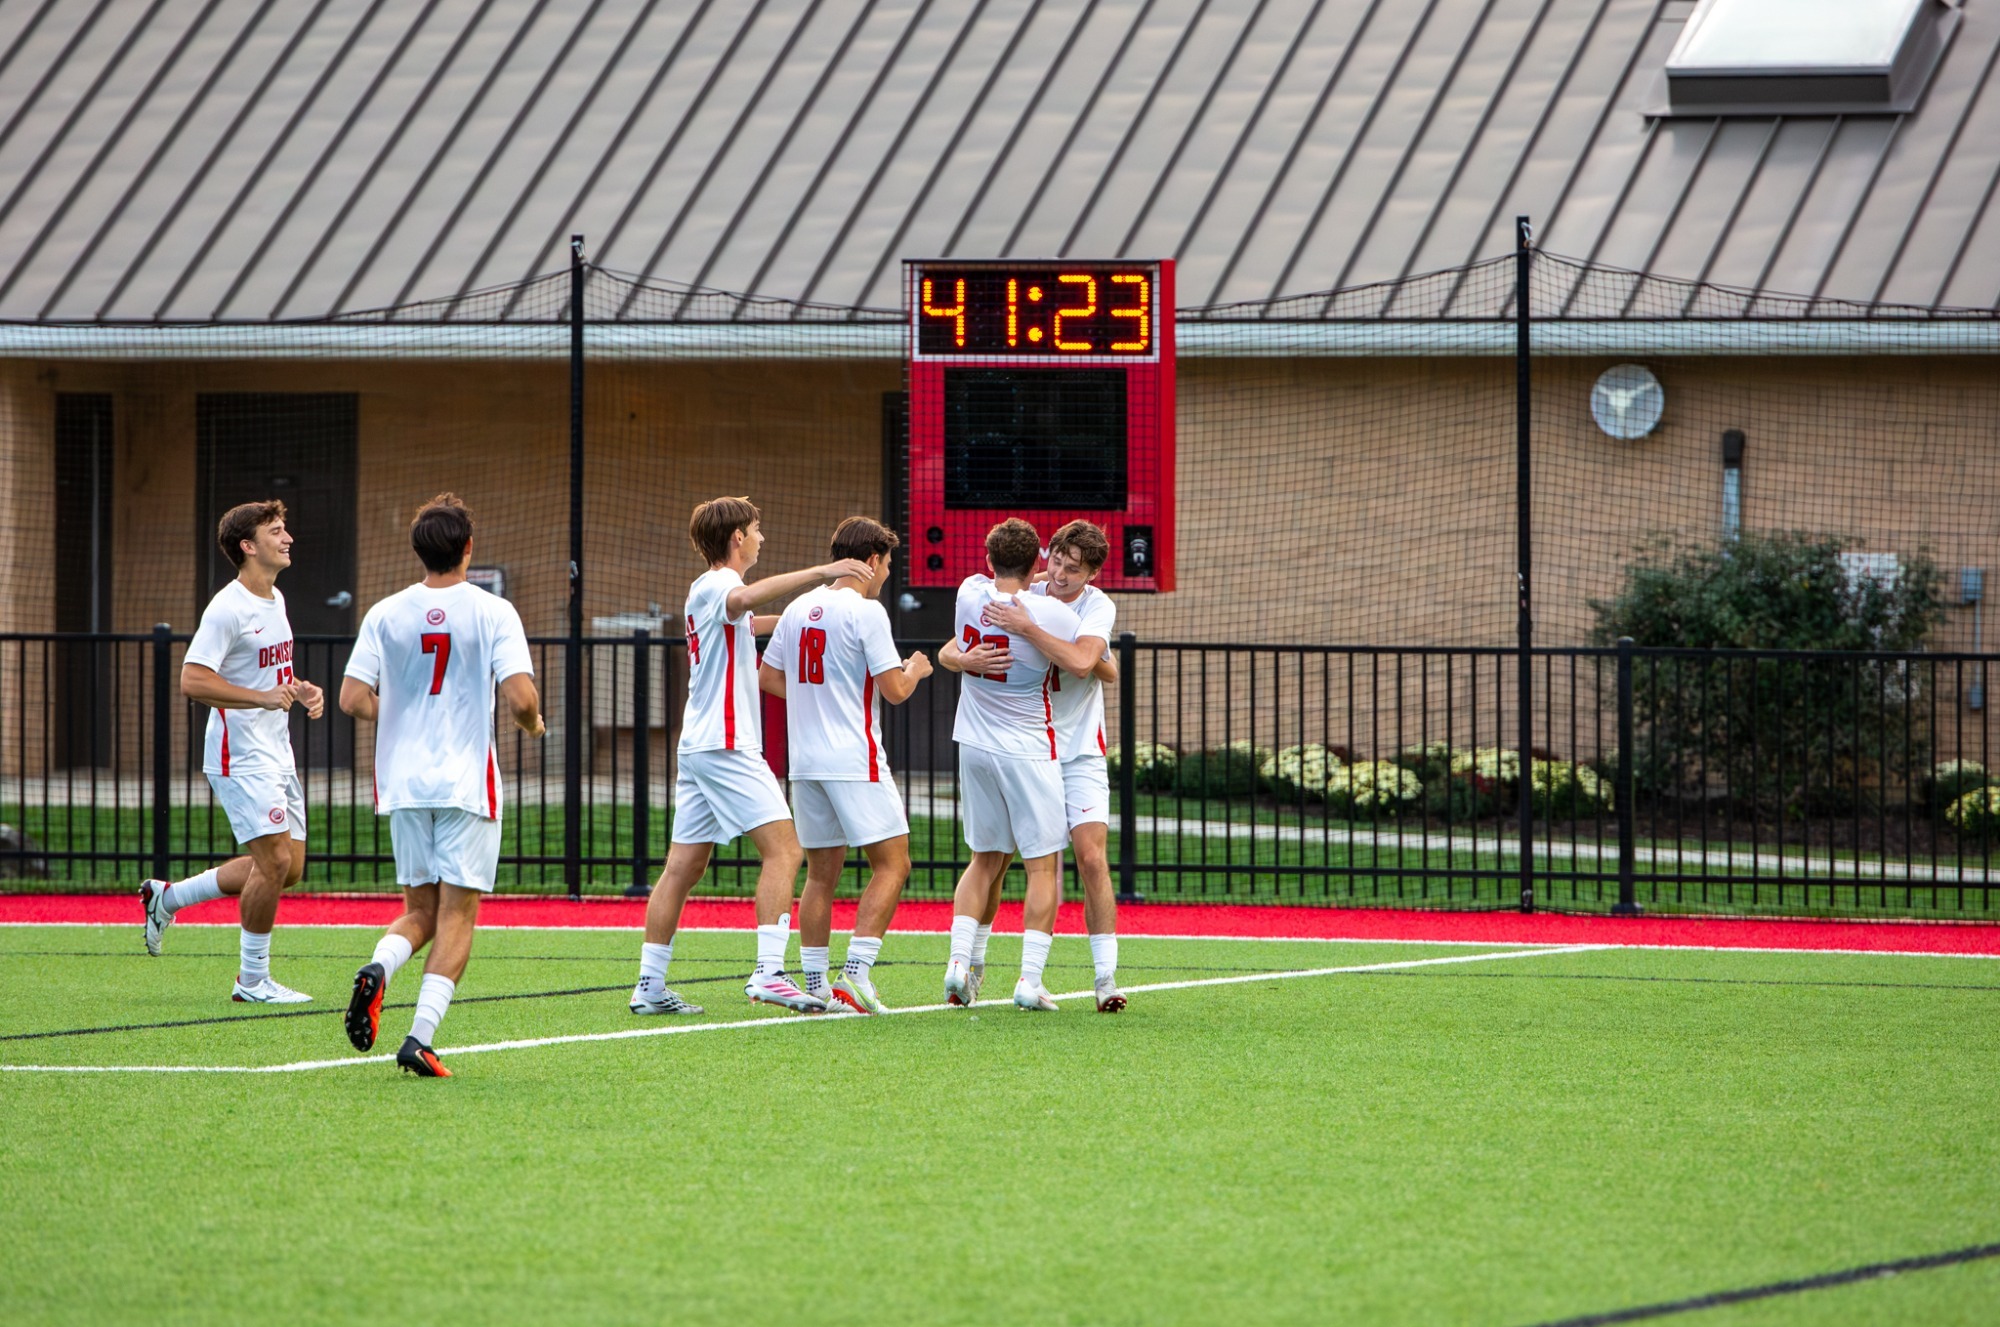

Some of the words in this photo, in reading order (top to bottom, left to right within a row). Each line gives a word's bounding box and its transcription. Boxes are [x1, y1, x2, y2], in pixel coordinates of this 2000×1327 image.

[923, 275, 1149, 351] 41:23
[421, 632, 451, 695] 7
[798, 626, 827, 685] 18
